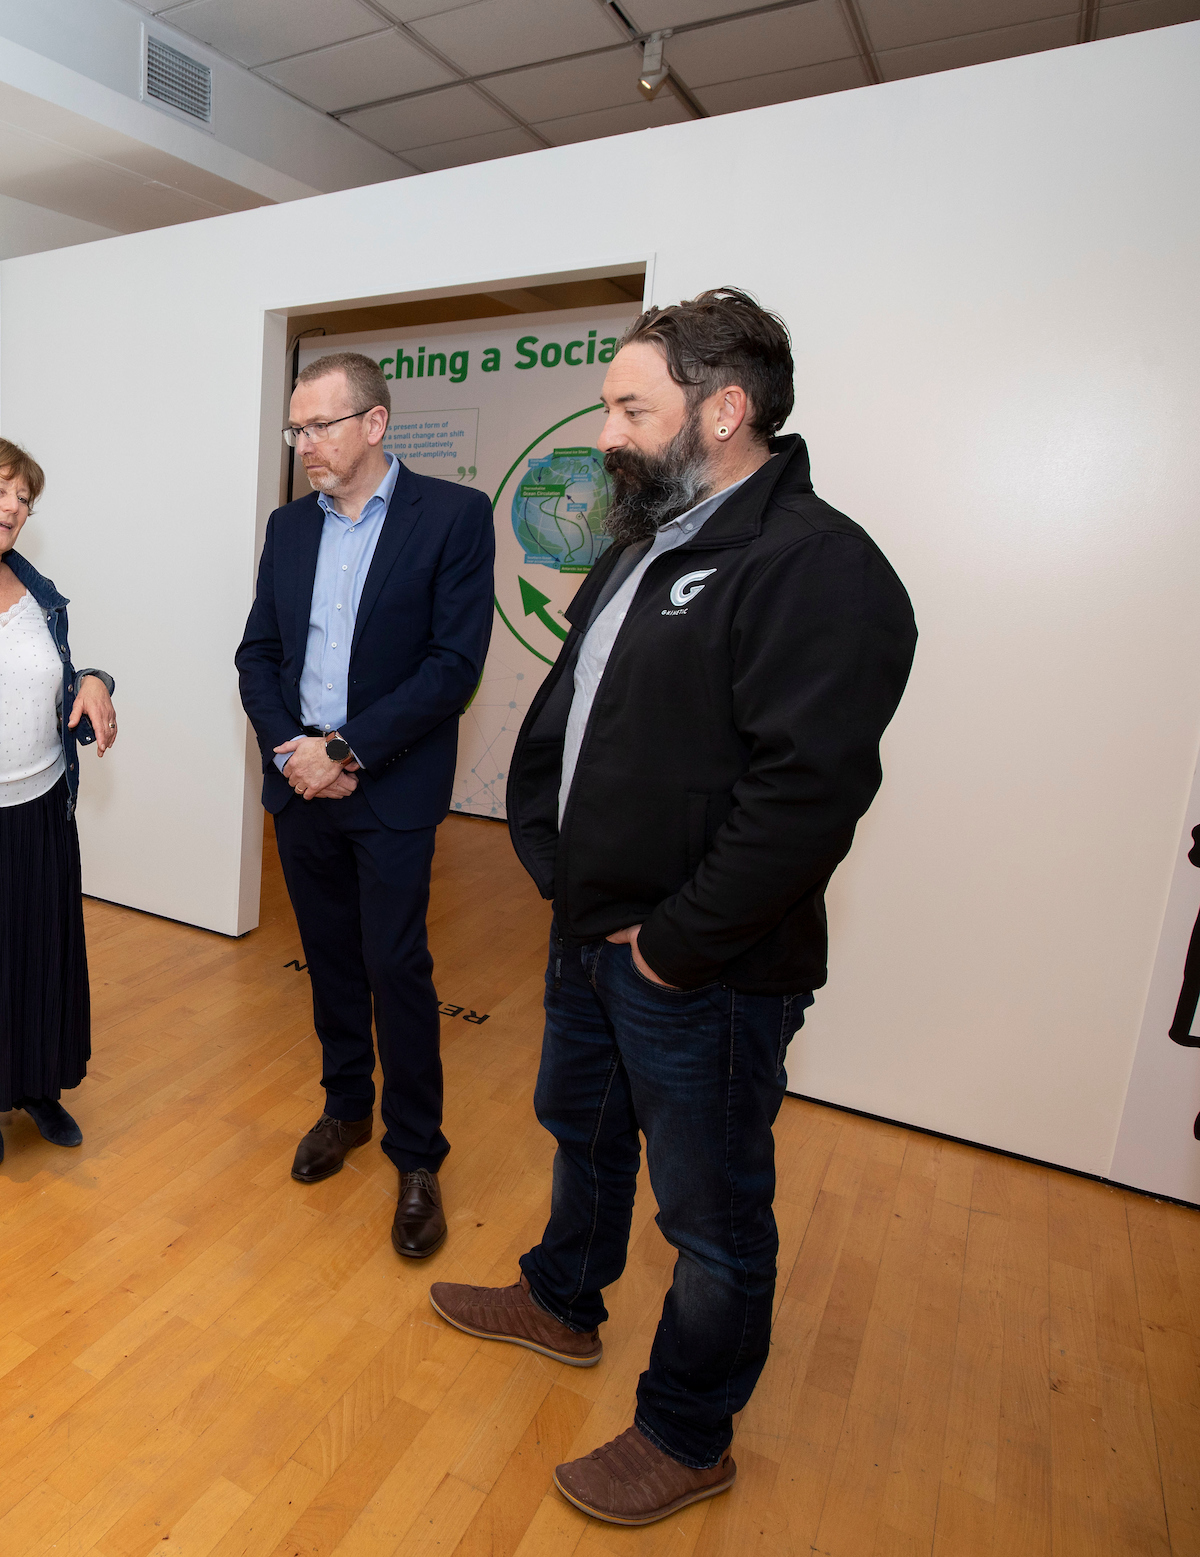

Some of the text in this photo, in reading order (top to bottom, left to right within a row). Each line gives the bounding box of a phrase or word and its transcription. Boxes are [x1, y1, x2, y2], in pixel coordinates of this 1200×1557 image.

[379, 329, 619, 383] ching a Socia
[393, 423, 418, 431] present
[412, 432, 435, 440] change
[413, 441, 454, 450] qualitatively
[409, 450, 457, 458] self-amplifying
